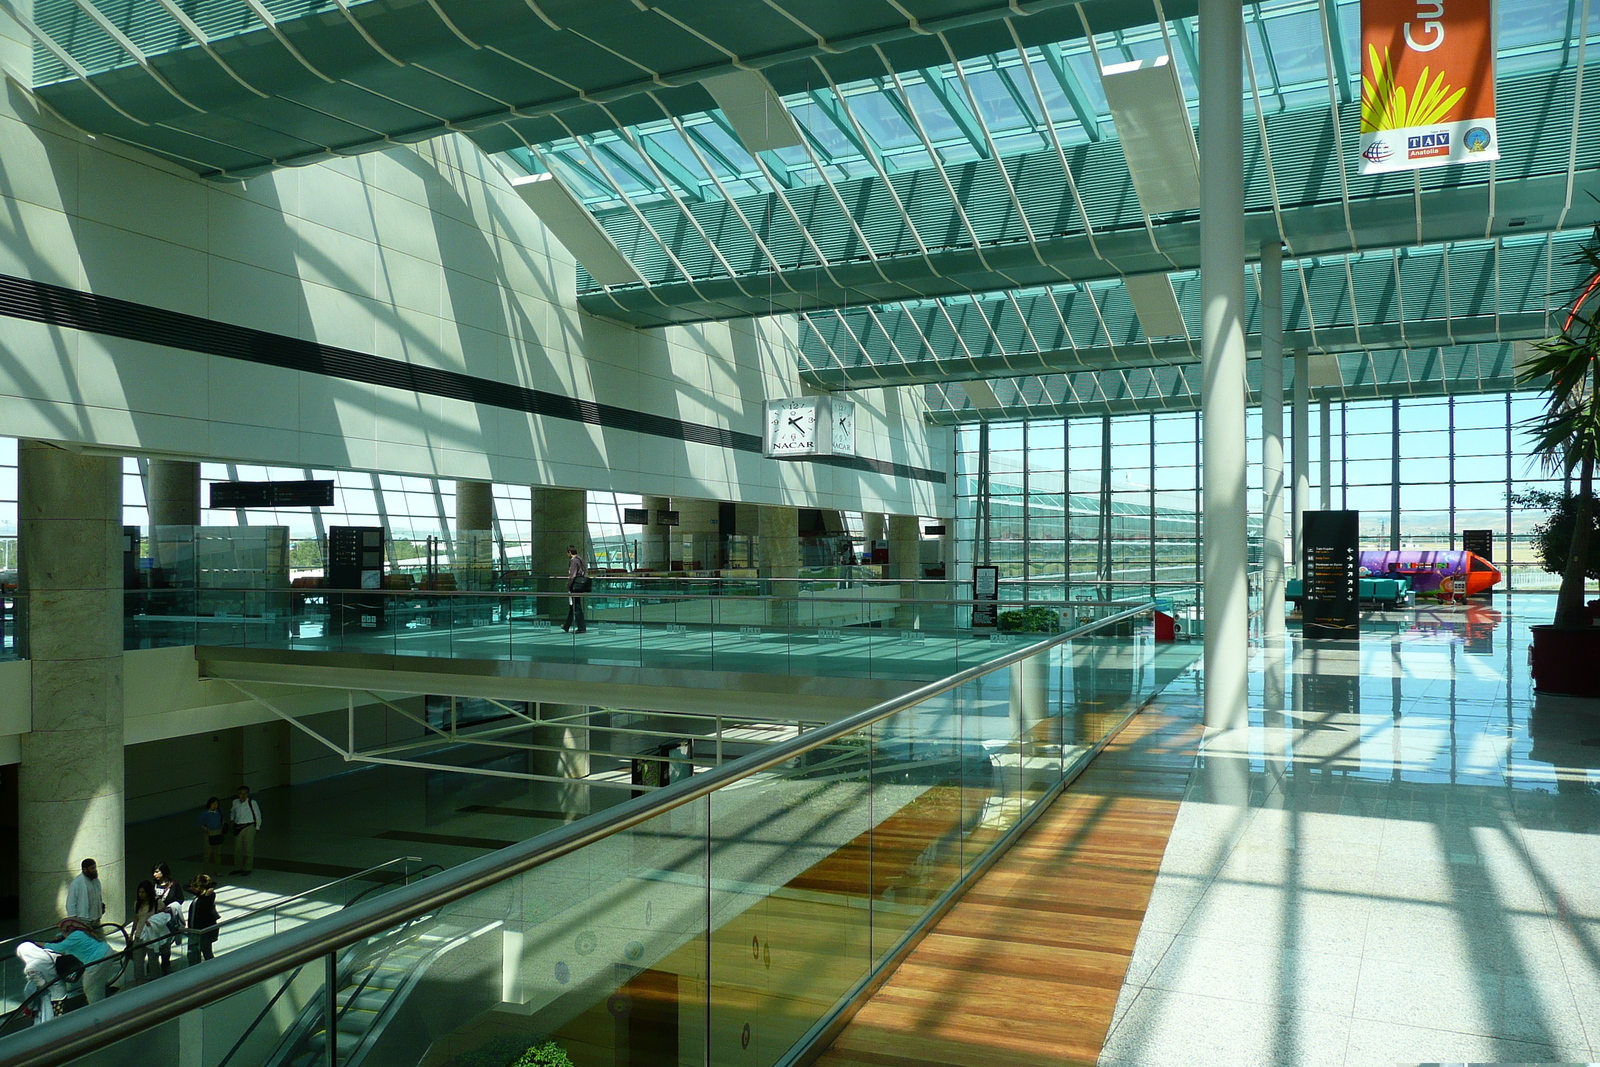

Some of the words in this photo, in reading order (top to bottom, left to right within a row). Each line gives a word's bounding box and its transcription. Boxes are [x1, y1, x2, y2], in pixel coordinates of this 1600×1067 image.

[1409, 134, 1448, 147] TAV
[1410, 148, 1439, 157] Anatolia
[773, 441, 815, 450] NACAR
